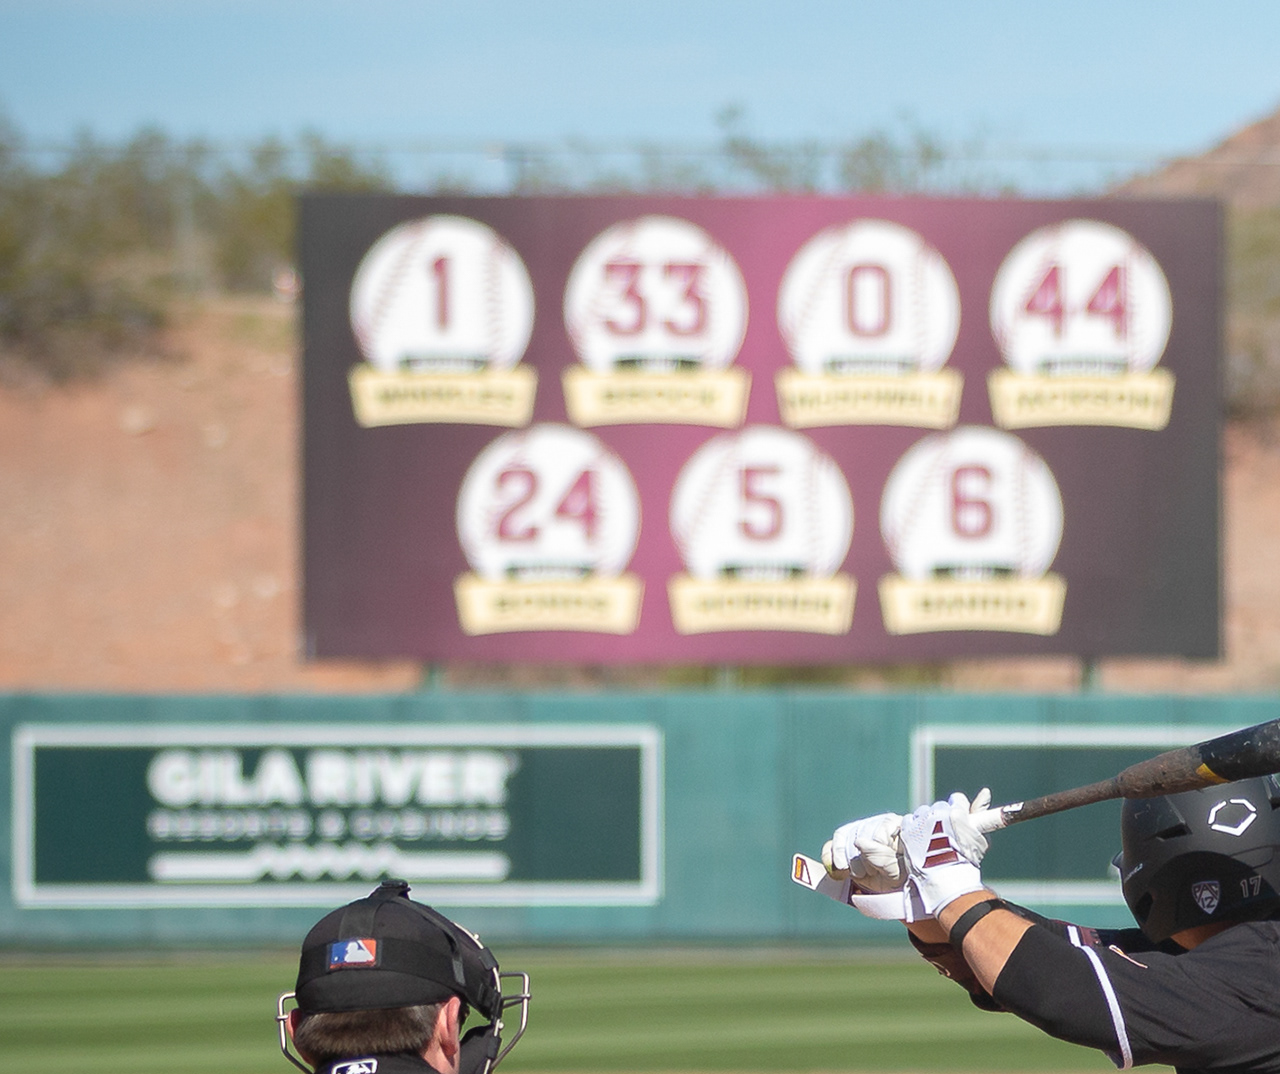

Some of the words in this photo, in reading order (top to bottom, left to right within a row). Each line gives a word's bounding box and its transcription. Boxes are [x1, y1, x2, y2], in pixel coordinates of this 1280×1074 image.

[428, 253, 455, 335] 1
[602, 259, 713, 342] 33
[843, 261, 895, 342] 0
[1020, 261, 1130, 342] 44
[491, 467, 601, 547] 24
[736, 465, 786, 546] 5
[946, 463, 997, 544] 6
[146, 748, 299, 808] GILA
[305, 748, 508, 808] RIVER
[1201, 896, 1216, 909] 12
[1240, 875, 1262, 898] 17
